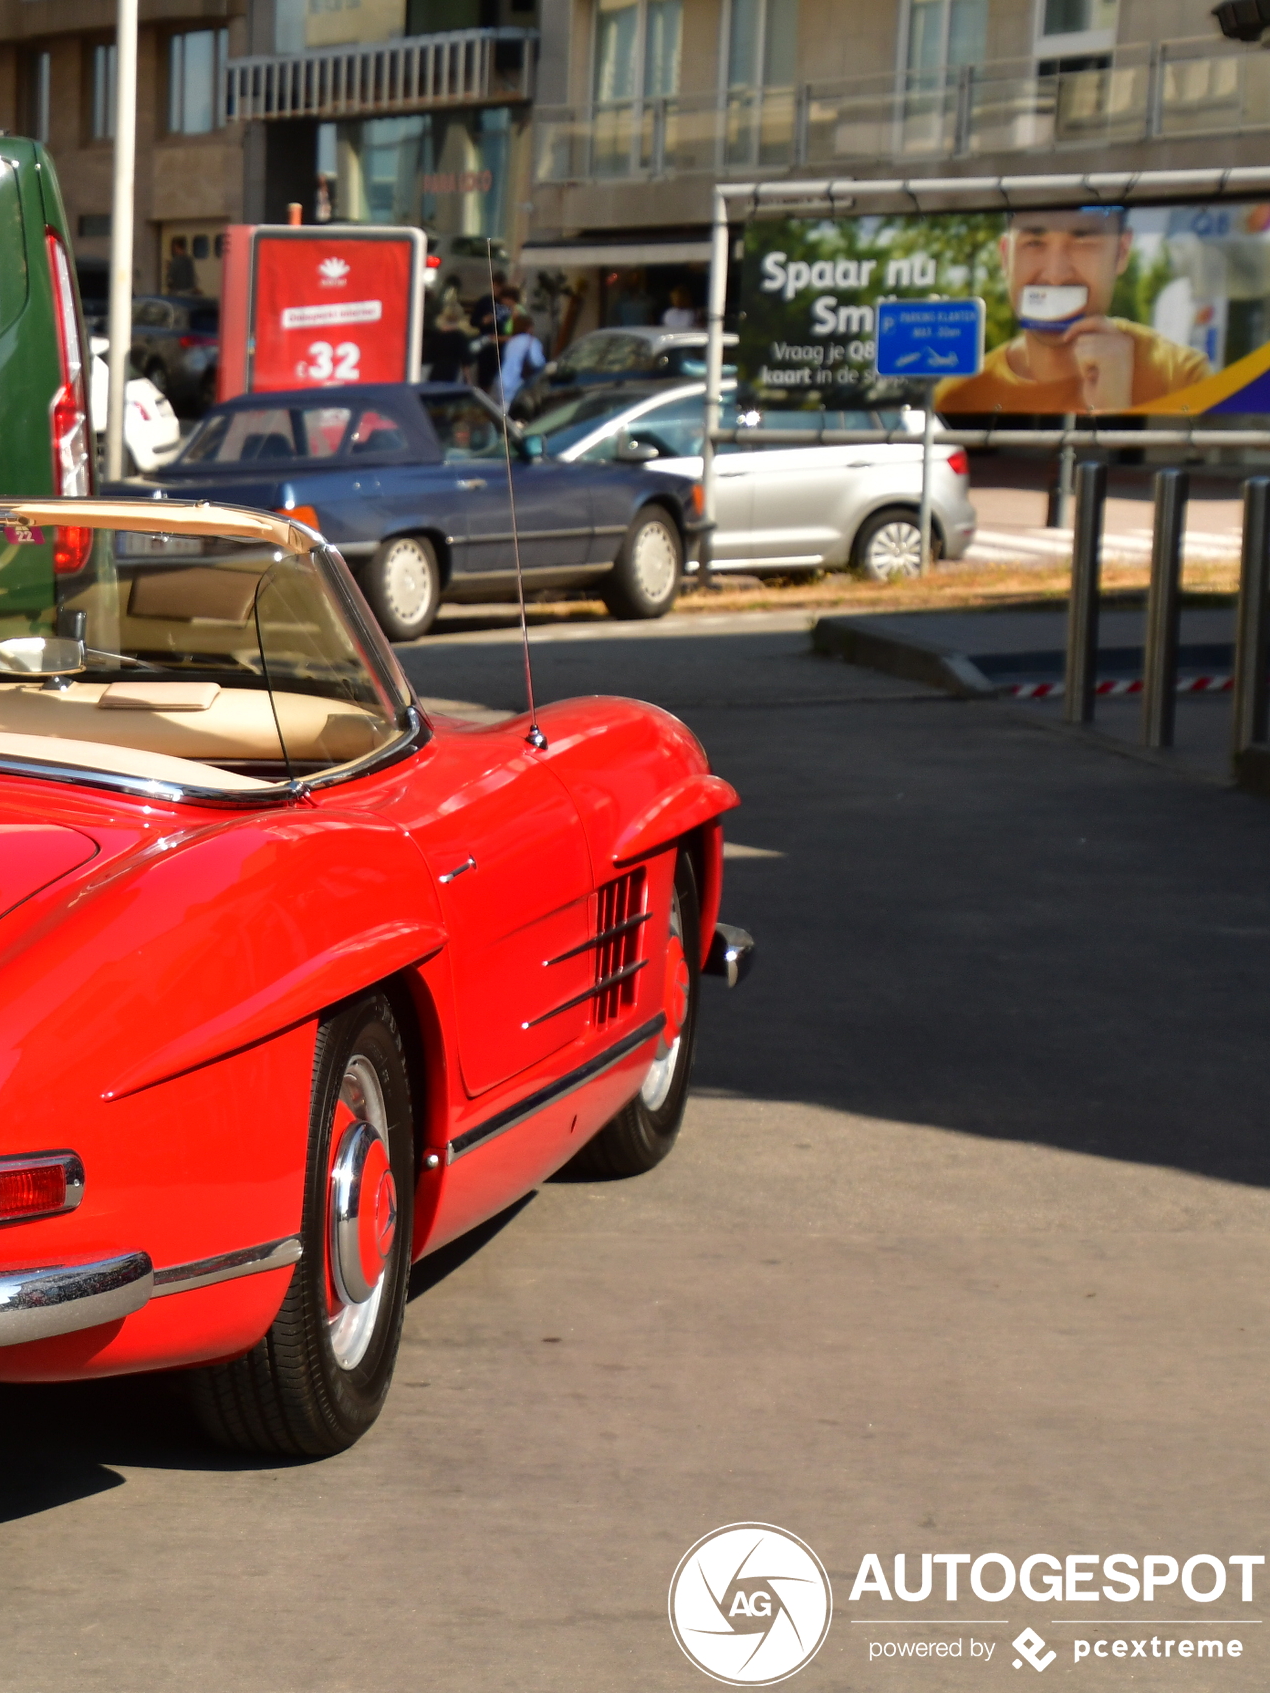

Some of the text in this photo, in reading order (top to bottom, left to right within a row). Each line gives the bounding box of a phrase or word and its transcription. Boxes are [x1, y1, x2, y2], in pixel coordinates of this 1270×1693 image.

[761, 251, 937, 300] Spaar nu
[773, 341, 824, 365] Vraag
[827, 341, 845, 366] je
[761, 365, 812, 385] kaart
[816, 365, 833, 385] in
[837, 365, 859, 385] de
